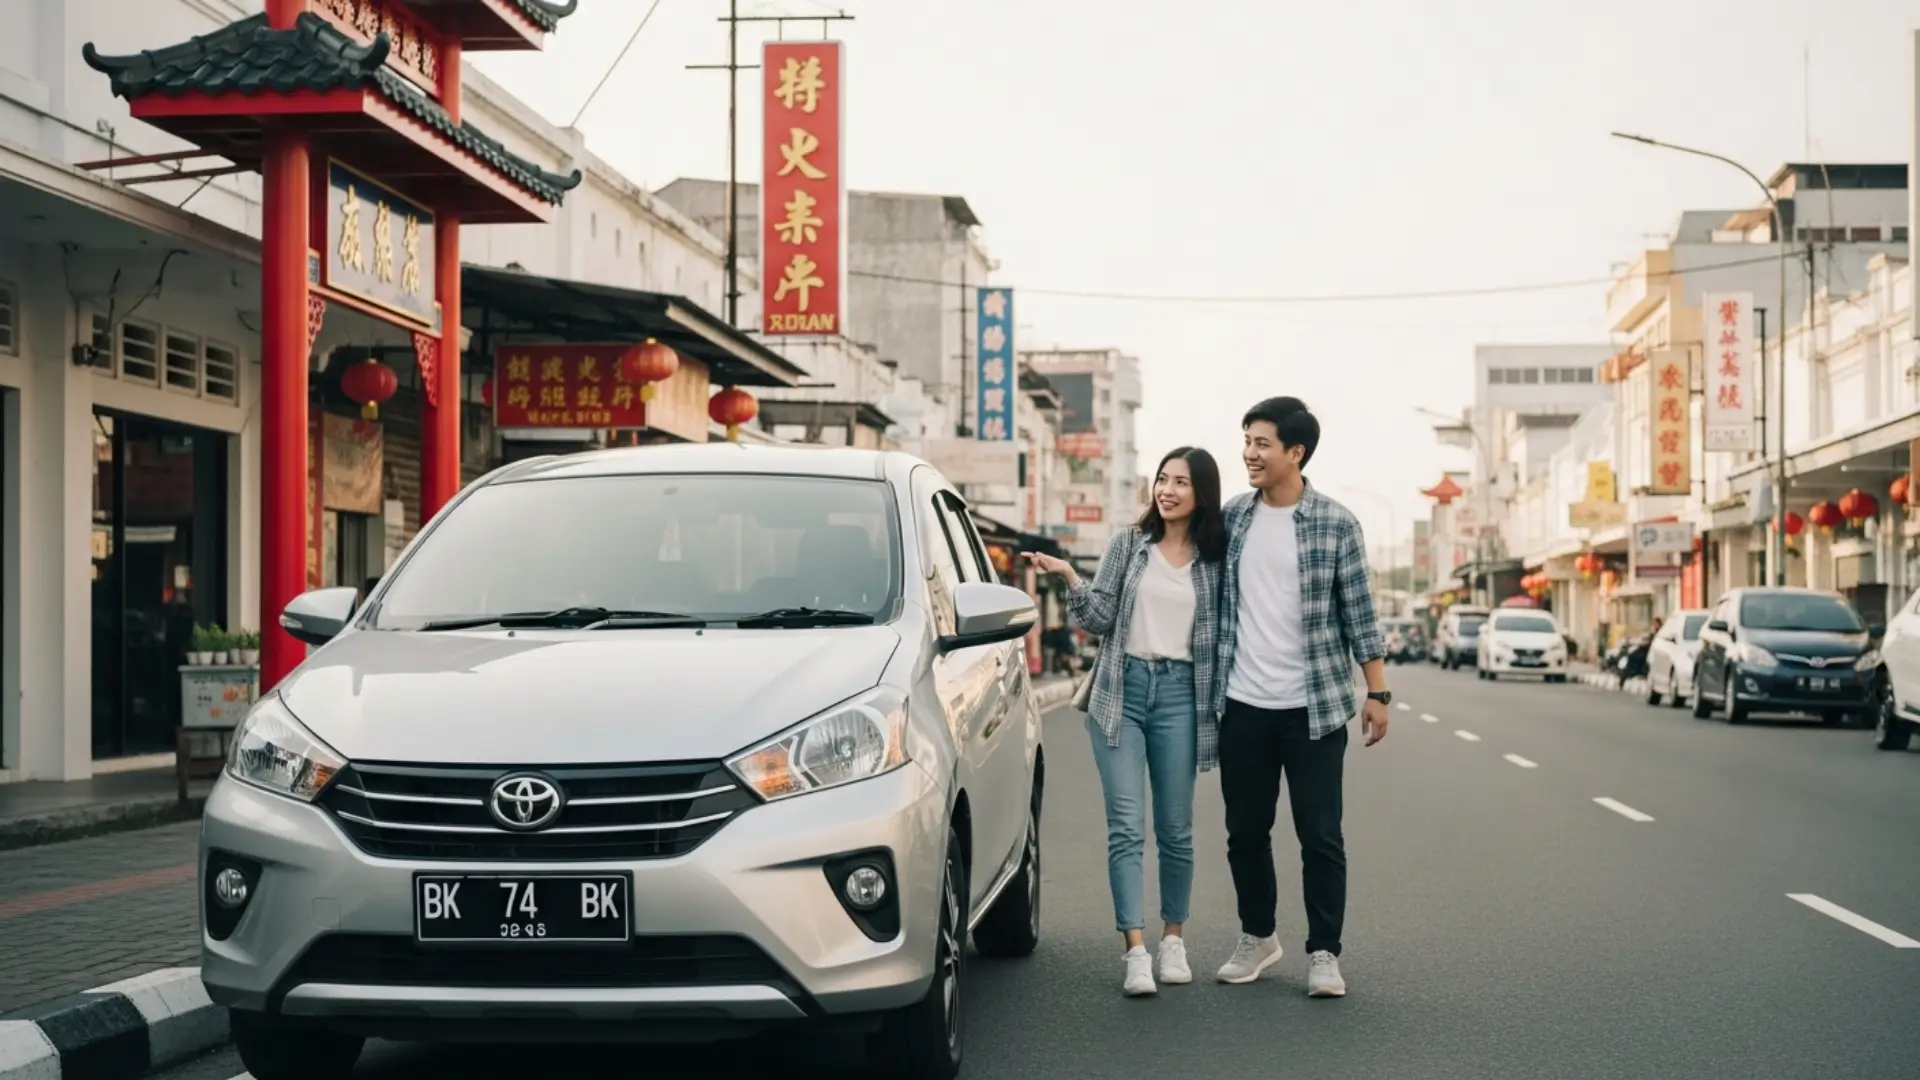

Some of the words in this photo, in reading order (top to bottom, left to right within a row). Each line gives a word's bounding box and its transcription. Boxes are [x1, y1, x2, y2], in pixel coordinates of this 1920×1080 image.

[423, 882, 462, 919] BK
[499, 882, 538, 919] 74
[581, 882, 619, 919] BK
